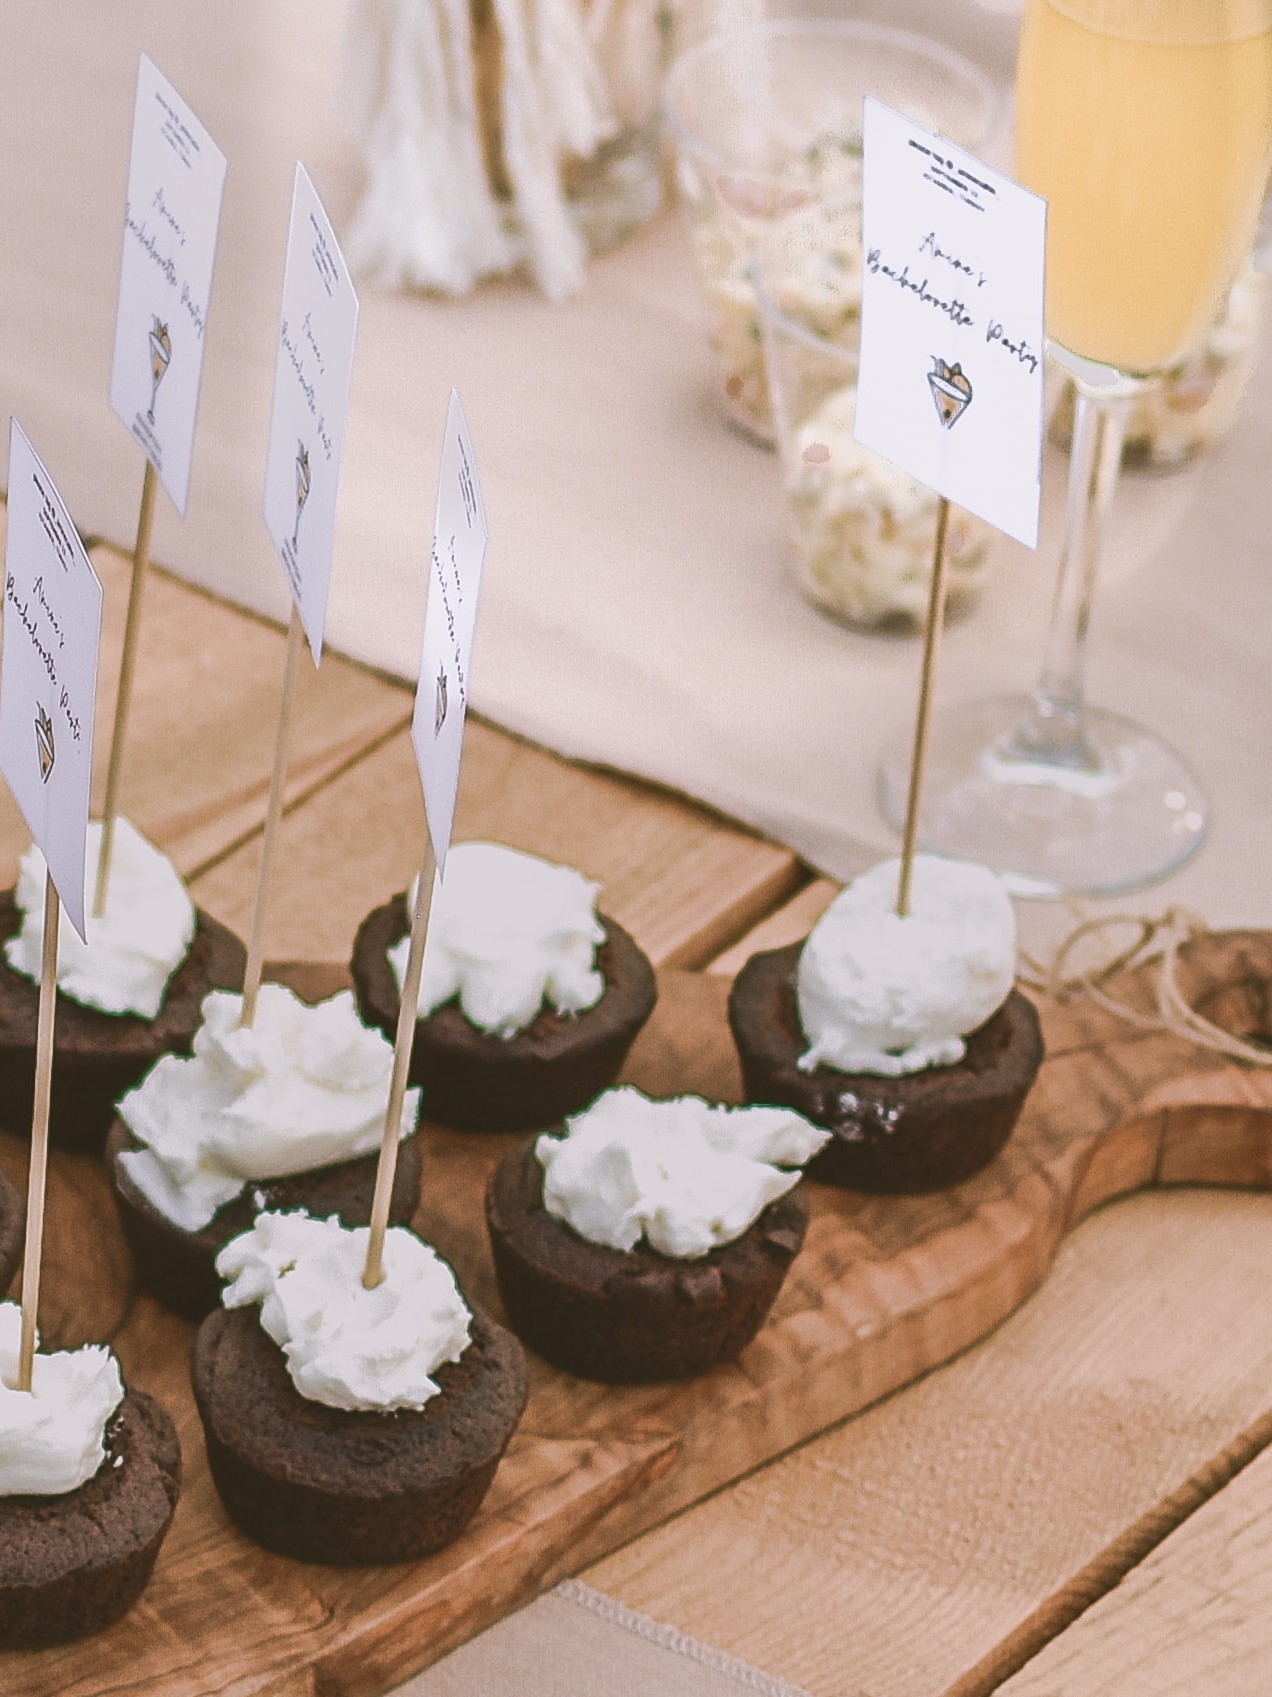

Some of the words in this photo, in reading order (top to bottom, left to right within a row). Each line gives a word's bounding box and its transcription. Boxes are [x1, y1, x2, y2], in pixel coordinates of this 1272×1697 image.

[866, 247, 975, 326] Bachelorette
[986, 318, 1039, 375] Party
[6, 571, 58, 686] Bachelorette
